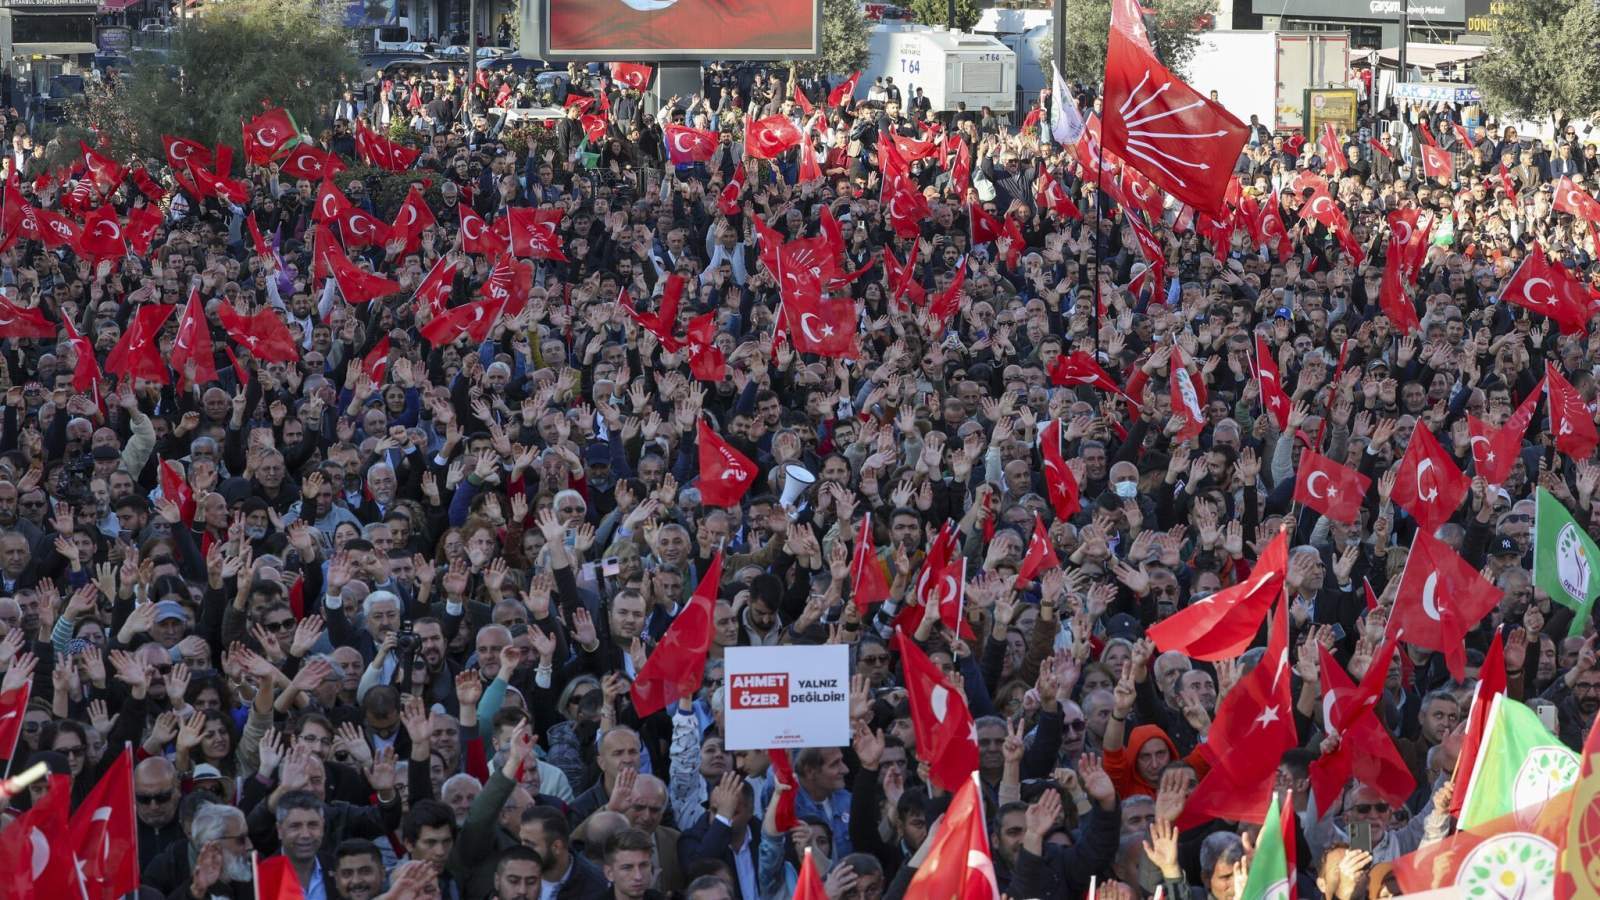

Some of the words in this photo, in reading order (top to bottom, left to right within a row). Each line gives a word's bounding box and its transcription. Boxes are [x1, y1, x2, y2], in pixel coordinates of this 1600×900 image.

[901, 59, 906, 73] T
[909, 60, 920, 74] 64
[22, 218, 38, 231] CH
[732, 674, 787, 688] AHMET
[798, 679, 838, 688] YALNIZ
[739, 691, 780, 707] ÖZER
[790, 691, 845, 703] DEĞİLDİR!
